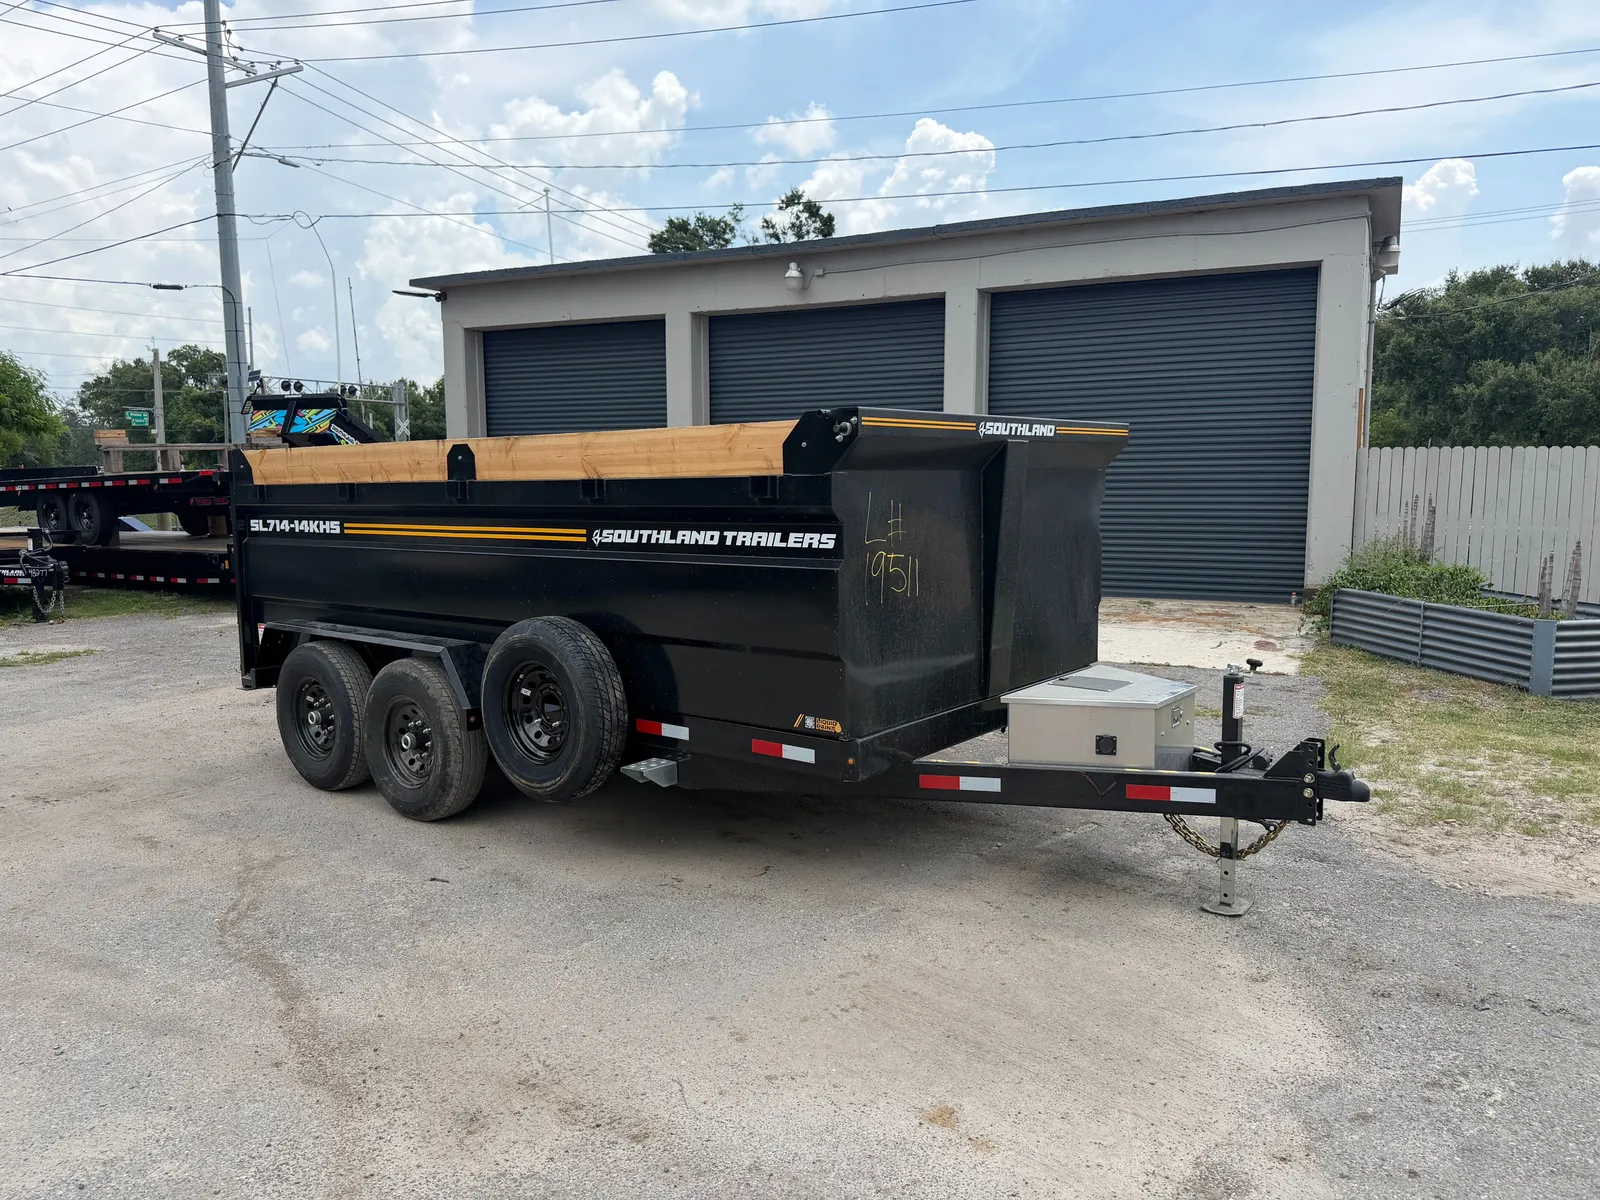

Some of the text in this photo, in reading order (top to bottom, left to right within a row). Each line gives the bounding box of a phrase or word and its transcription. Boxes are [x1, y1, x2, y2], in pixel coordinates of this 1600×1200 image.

[984, 422, 1056, 437] SOUTHLAND
[250, 519, 340, 534] SL714-14KHS
[601, 529, 837, 549] SOUTHLAND TRAILERS
